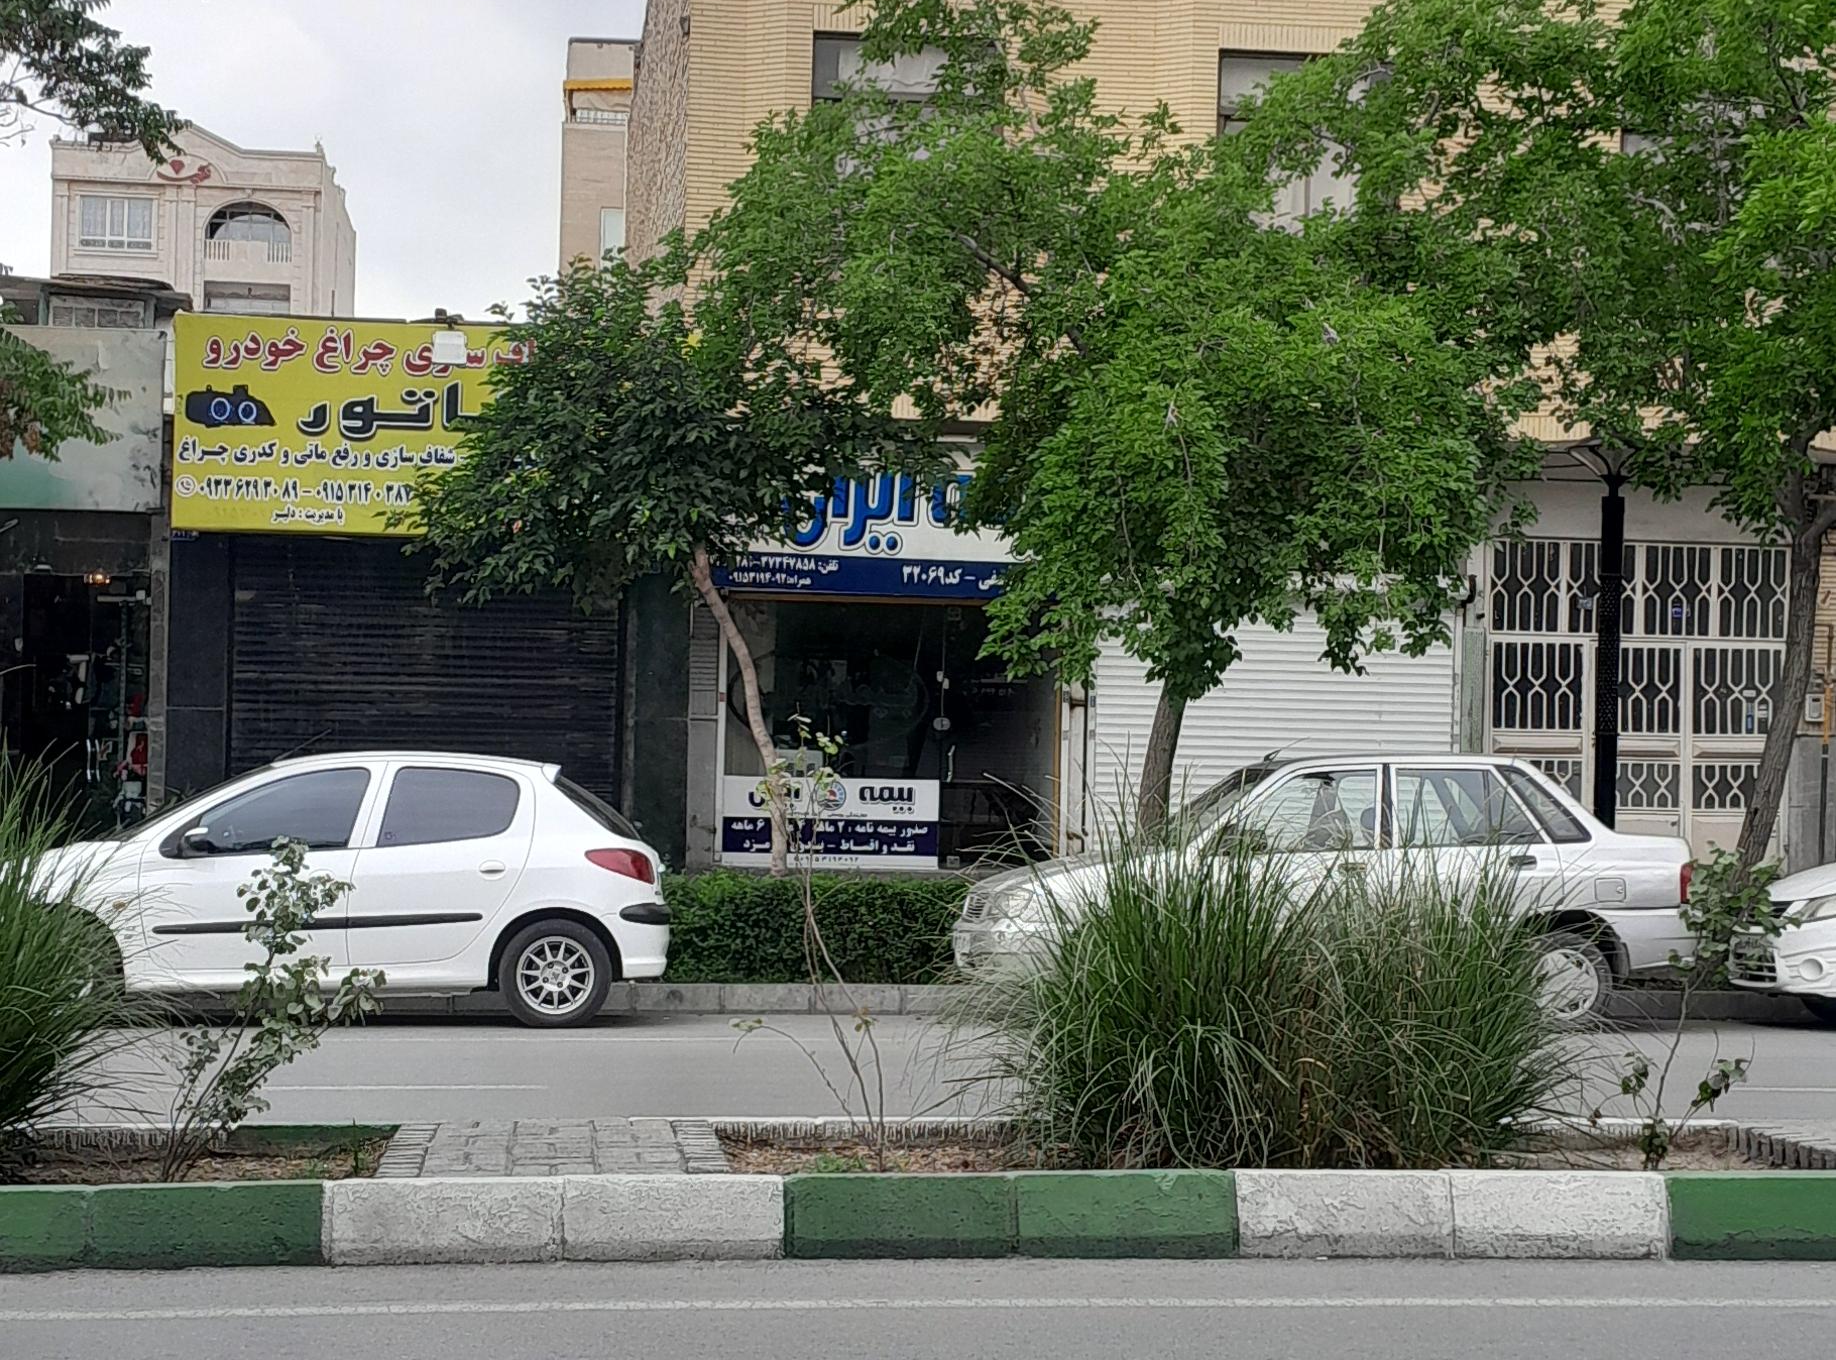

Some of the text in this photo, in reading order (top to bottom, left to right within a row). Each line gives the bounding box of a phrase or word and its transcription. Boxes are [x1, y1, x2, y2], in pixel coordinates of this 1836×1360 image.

[203, 327, 307, 369] خودرو
[314, 327, 396, 375] چراغ
[298, 381, 484, 438] اتور
[178, 437, 456, 468] شفاف سازی و رفع ماتی و کدری چراغ
[858, 786, 915, 812] بیمه
[730, 819, 754, 831] ماهه
[854, 821, 875, 833] نامه
[876, 824, 897, 837] بیمه
[839, 839, 880, 851] اقساط
[890, 839, 915, 851] نقد
